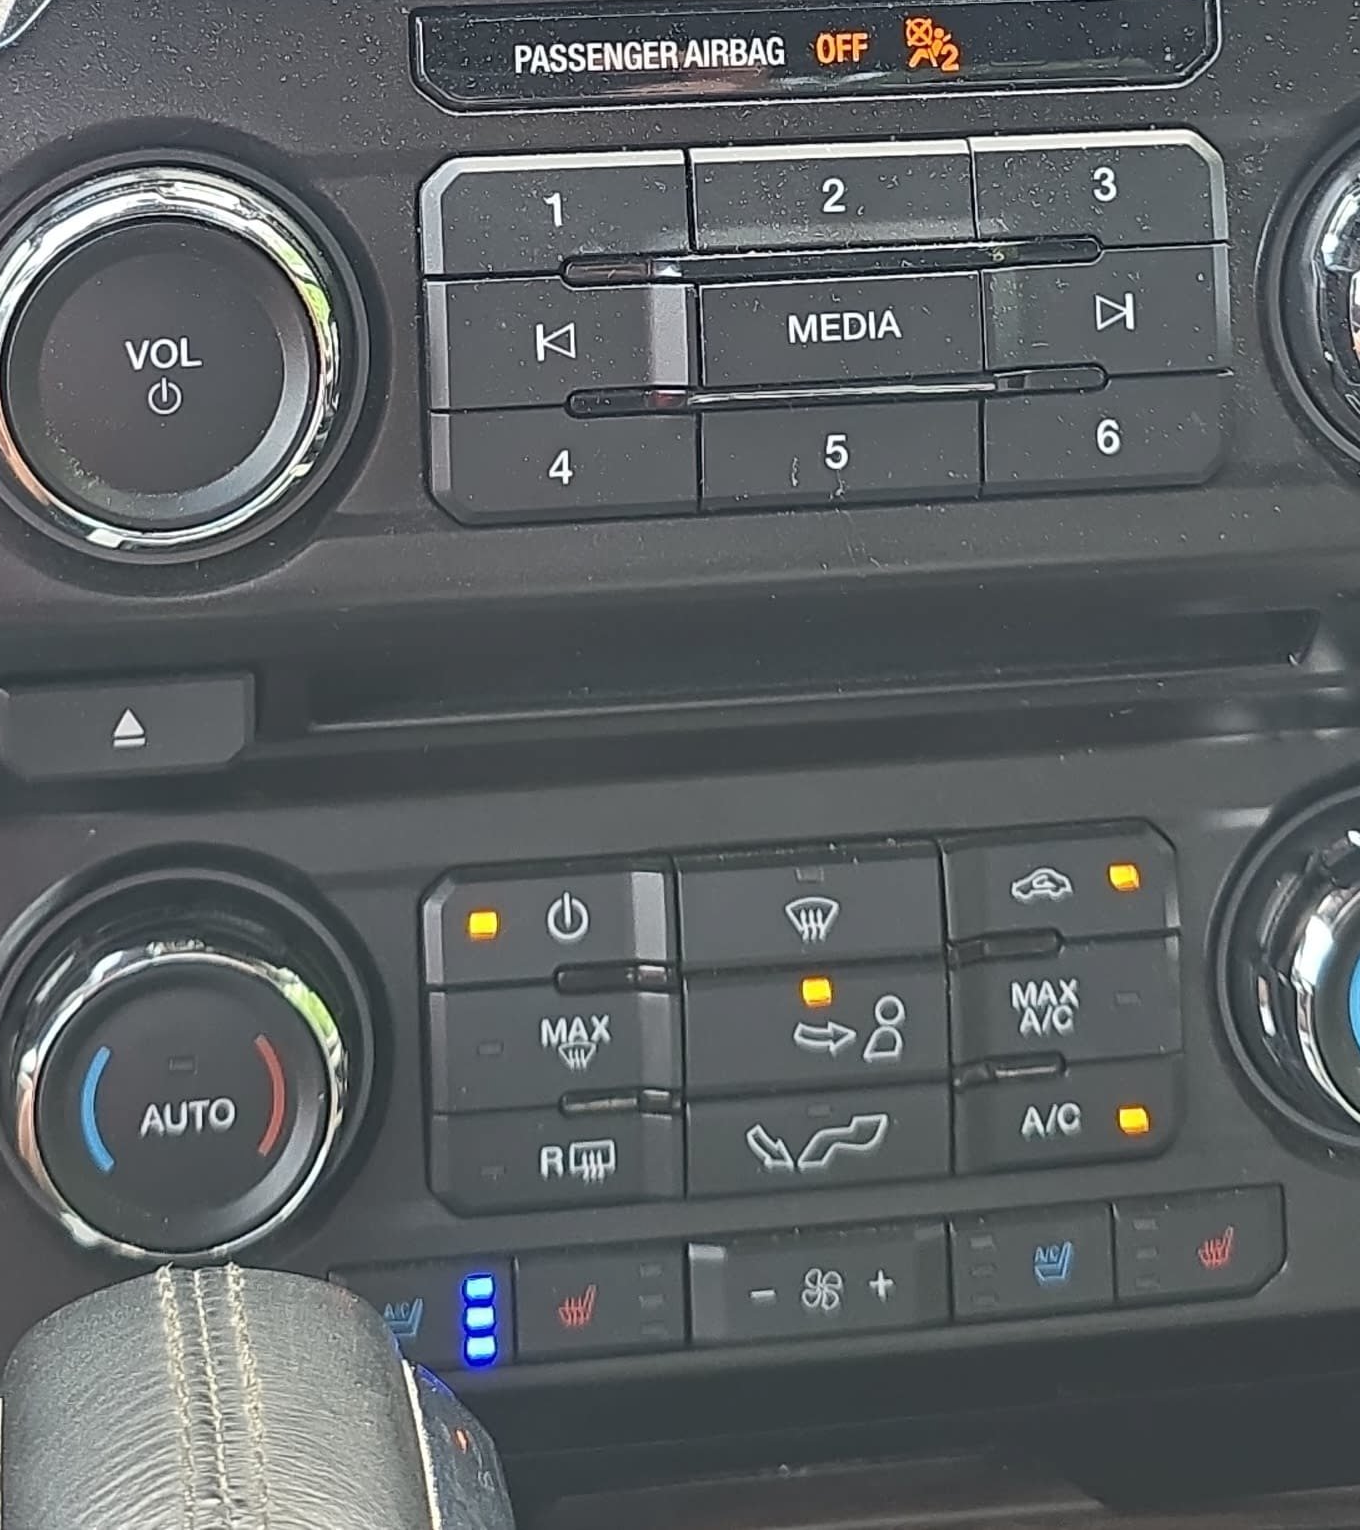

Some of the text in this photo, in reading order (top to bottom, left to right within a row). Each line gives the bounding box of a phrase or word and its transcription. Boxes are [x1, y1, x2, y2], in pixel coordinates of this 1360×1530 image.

[514, 36, 786, 74] PASSENGER AIRBAG
[815, 32, 869, 64] OFF
[823, 179, 846, 213] 2
[1092, 167, 1118, 202] 3
[546, 193, 564, 227] 1
[788, 310, 902, 345] MEDIA
[124, 338, 202, 370] VOL
[824, 434, 848, 470] 5
[1096, 419, 1122, 455] 6
[548, 449, 573, 485] 4
[1010, 978, 1079, 1012] MAX
[540, 1014, 611, 1048] MAX
[1019, 1005, 1075, 1037] A/C
[141, 1098, 236, 1139] AUTO
[1020, 1102, 1081, 1138] A/C
[540, 1145, 564, 1178] R
